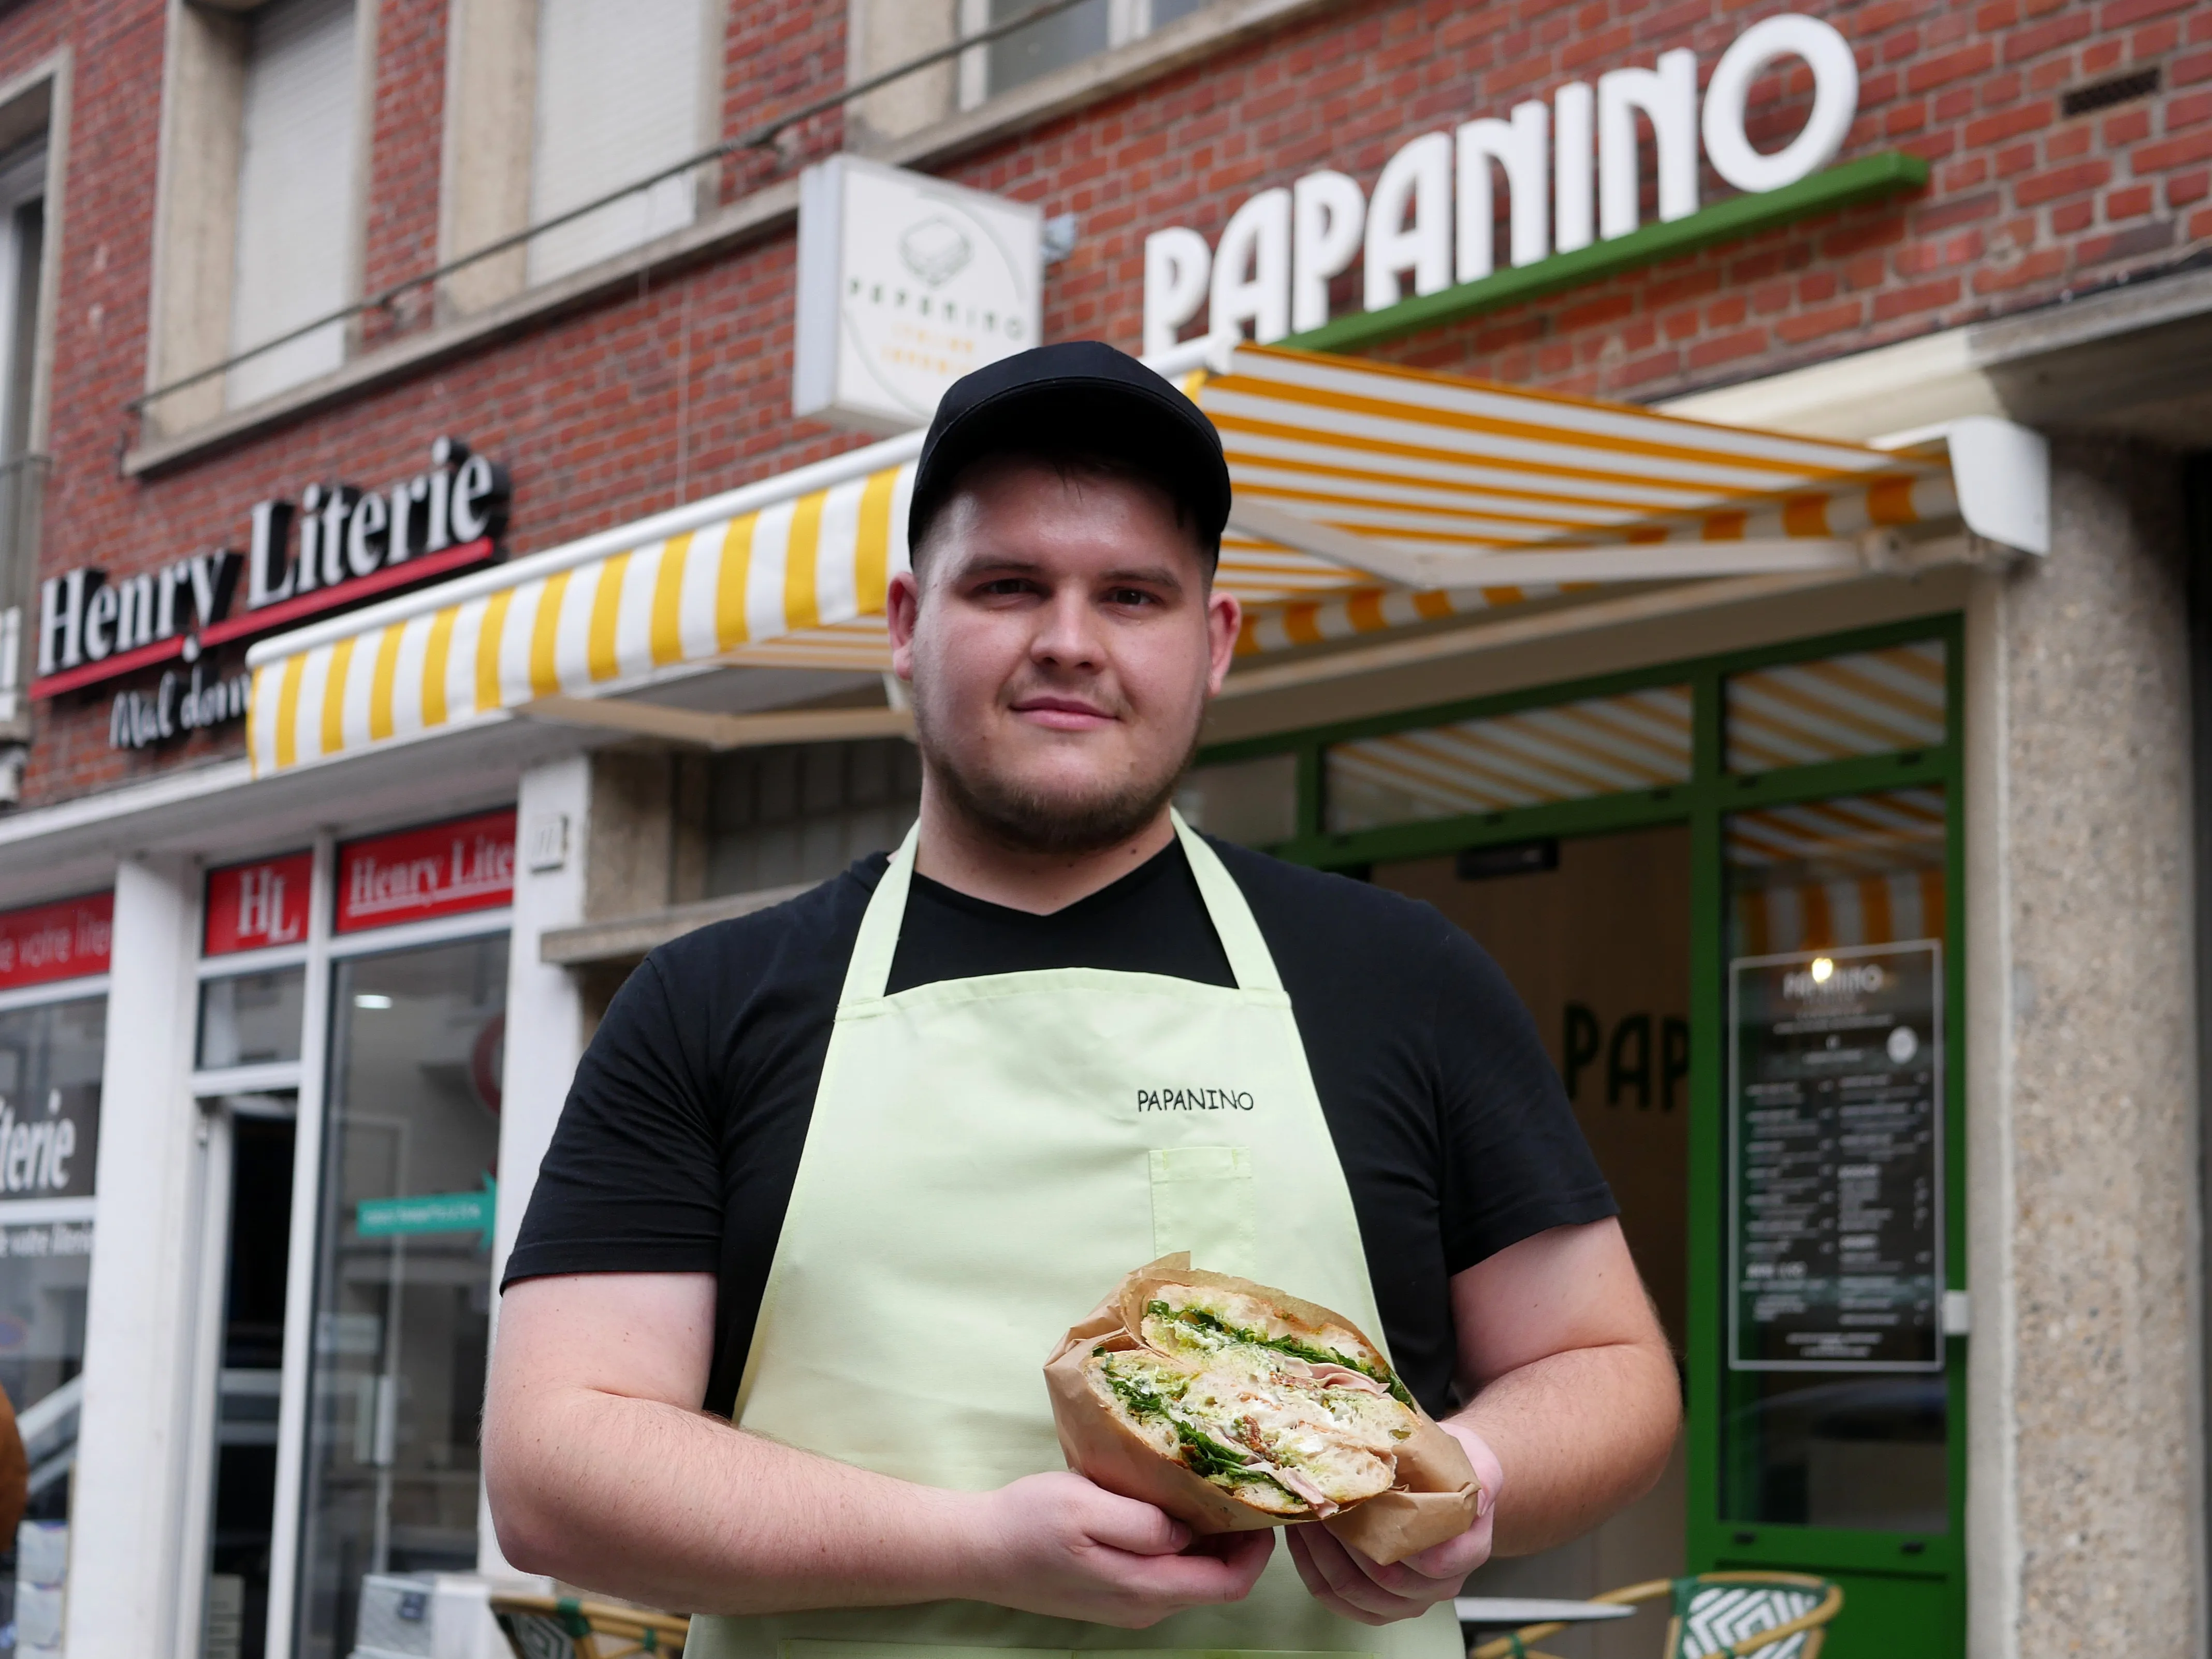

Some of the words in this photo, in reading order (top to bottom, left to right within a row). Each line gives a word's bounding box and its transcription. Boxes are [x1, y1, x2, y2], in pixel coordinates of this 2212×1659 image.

[1142, 12, 1860, 358] PAPANINO
[36, 549, 228, 676] Henry
[246, 435, 494, 610] Literie
[109, 670, 175, 749] Mal
[237, 867, 301, 941] HL
[349, 854, 444, 907] Henry
[1562, 999, 1690, 1112] PAP
[1138, 1088, 1254, 1112] PAPANINO
